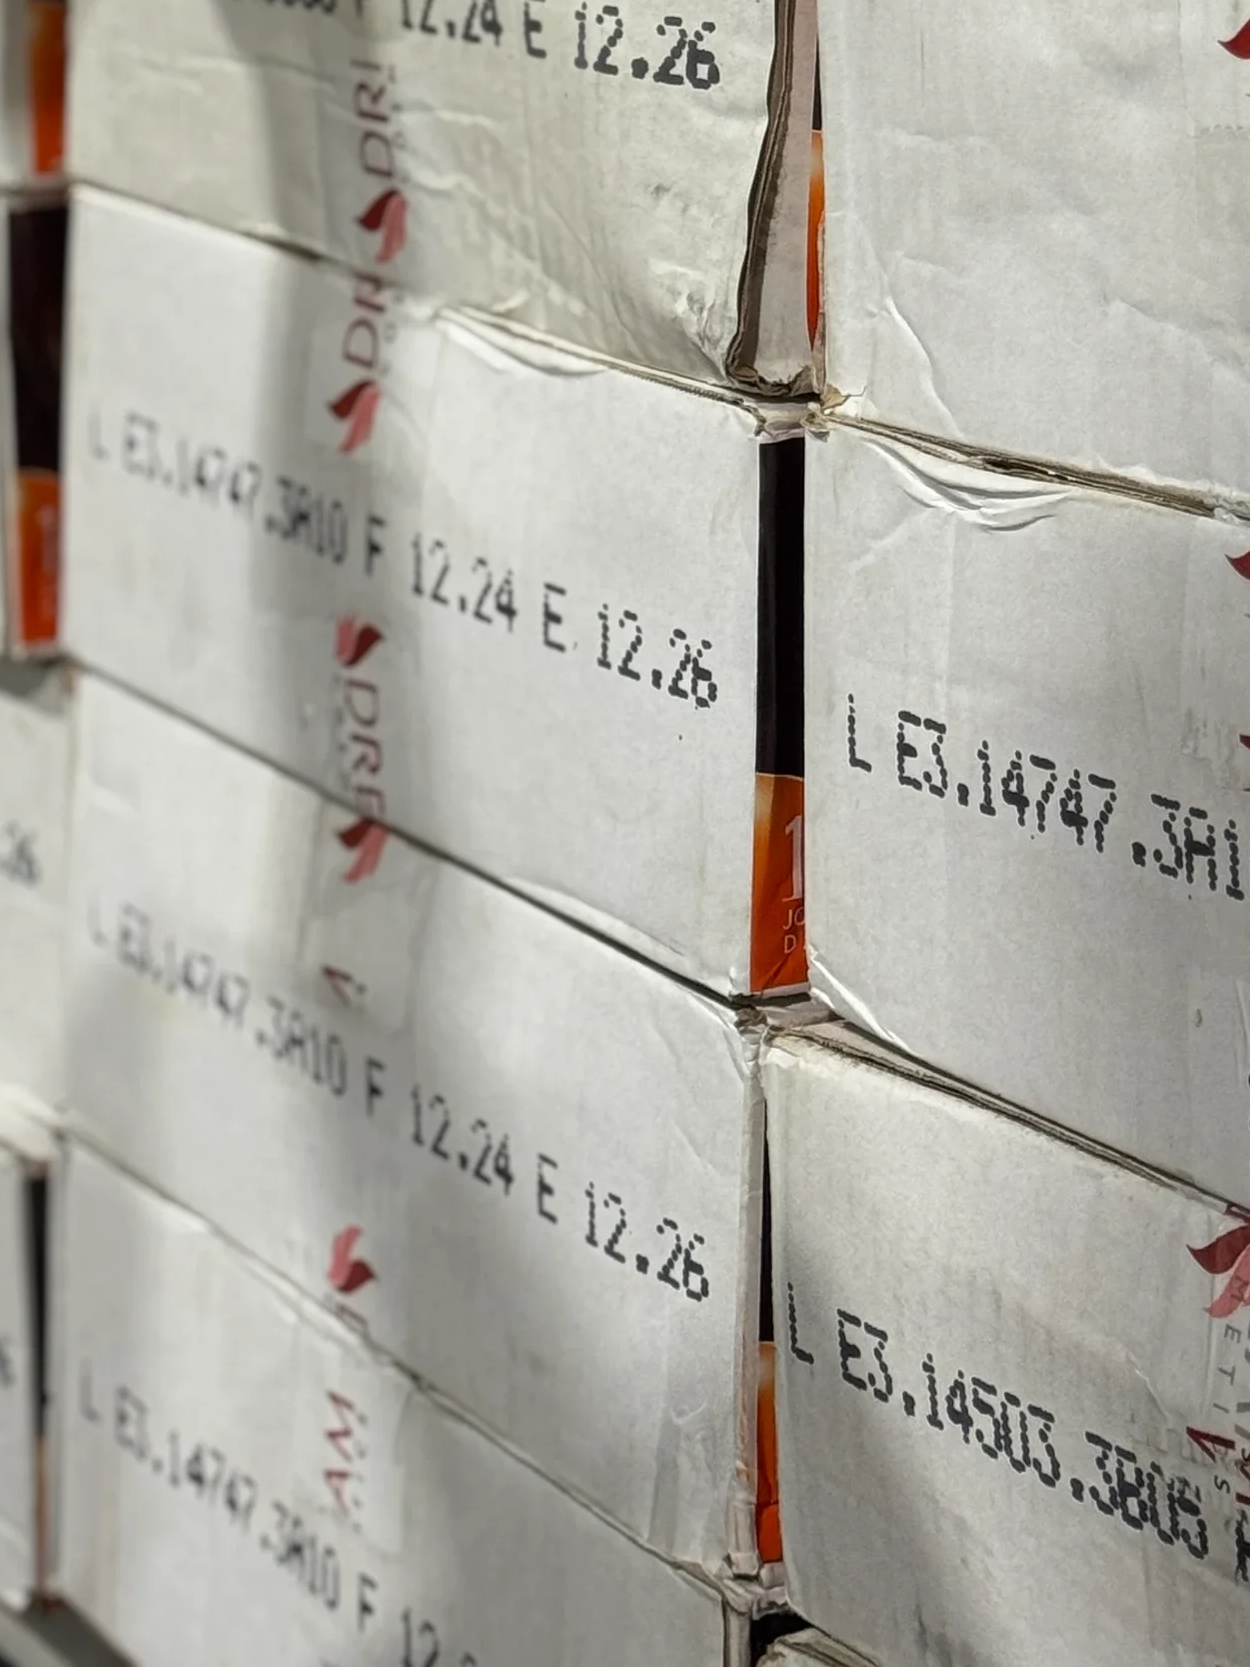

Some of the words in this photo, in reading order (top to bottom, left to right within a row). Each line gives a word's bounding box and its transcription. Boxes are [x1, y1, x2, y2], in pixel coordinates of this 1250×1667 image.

[573, 0, 721, 91] 12.26
[364, 509, 388, 579] F
[409, 530, 519, 634] 12.24
[542, 581, 568, 654] E
[595, 602, 718, 711] 12.26
[847, 692, 874, 774] L
[364, 1053, 388, 1119] F
[409, 1083, 515, 1198] 12.24
[536, 1151, 559, 1226] E
[584, 1180, 710, 1303] 12.26
[787, 1281, 815, 1366] L
[357, 1571, 379, 1638] F
